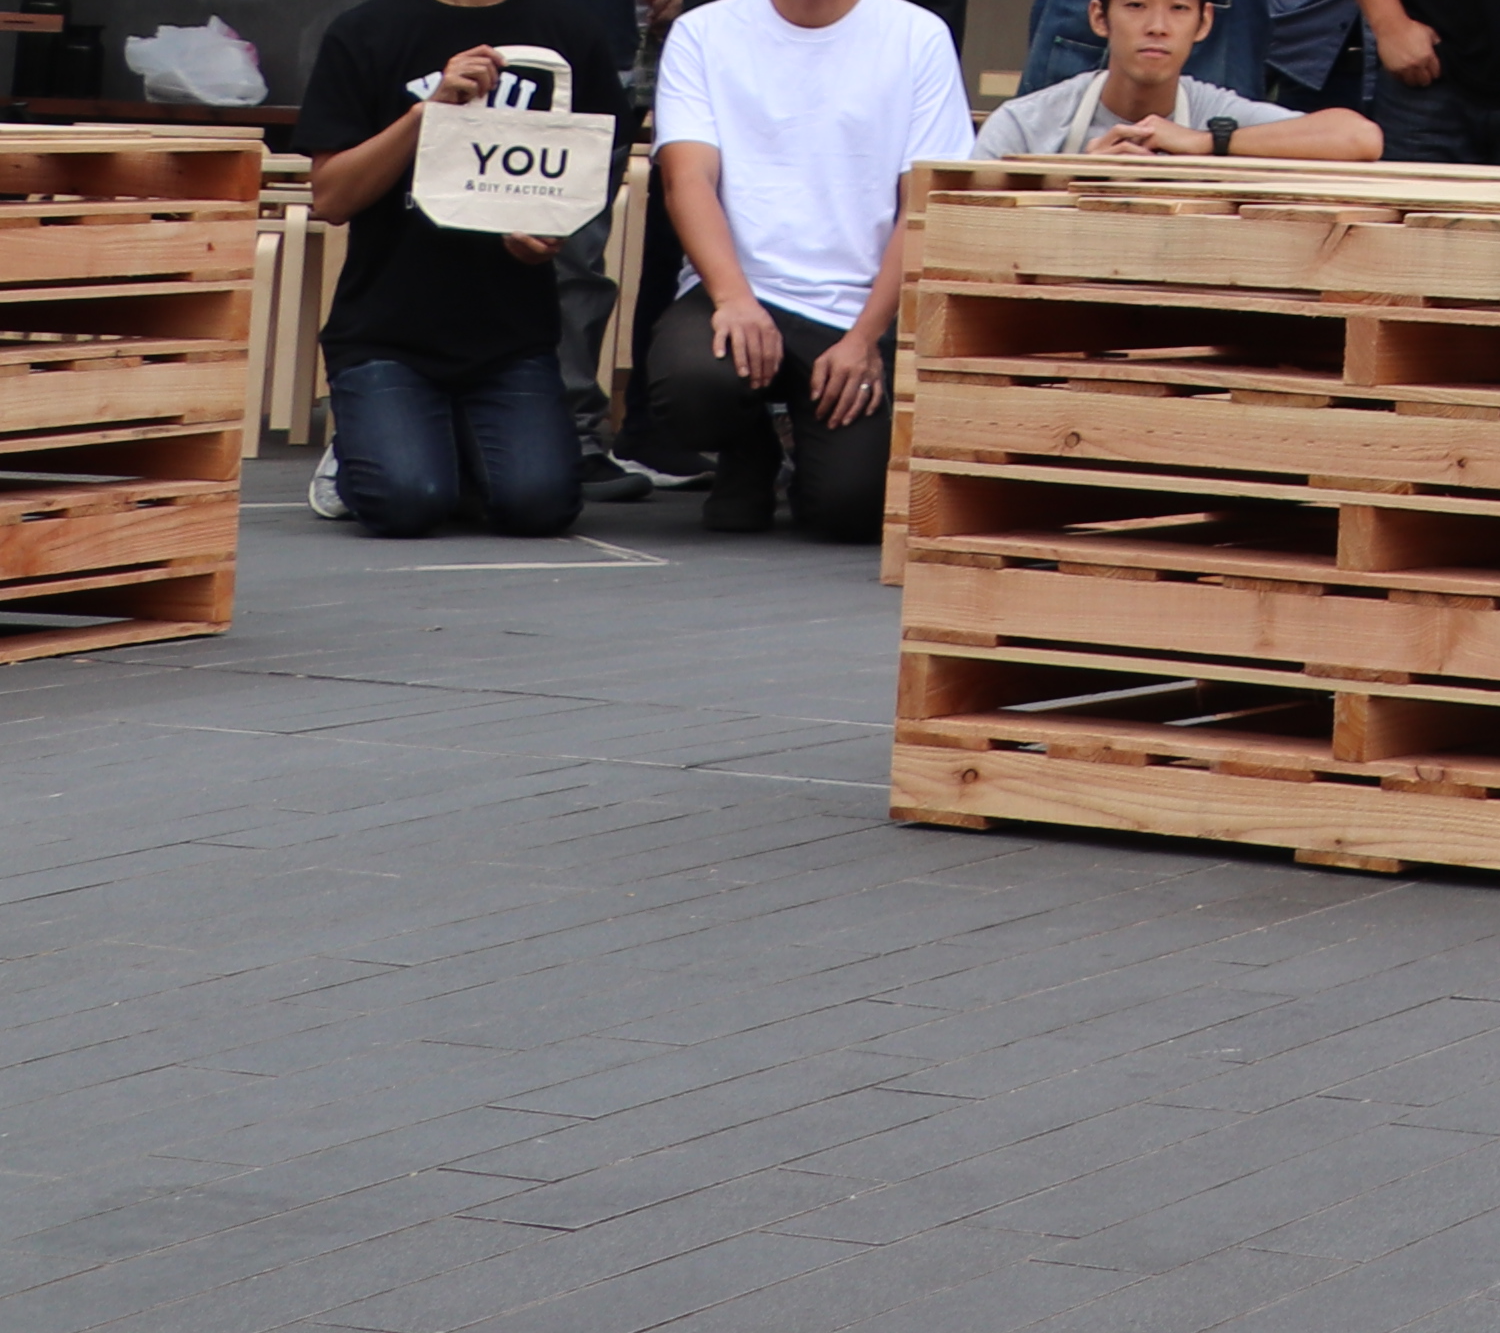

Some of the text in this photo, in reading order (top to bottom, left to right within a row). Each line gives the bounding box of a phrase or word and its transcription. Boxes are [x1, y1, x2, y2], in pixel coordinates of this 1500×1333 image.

[471, 142, 569, 179] YOU
[478, 182, 500, 193] DIY
[505, 184, 565, 197] FACTORY
